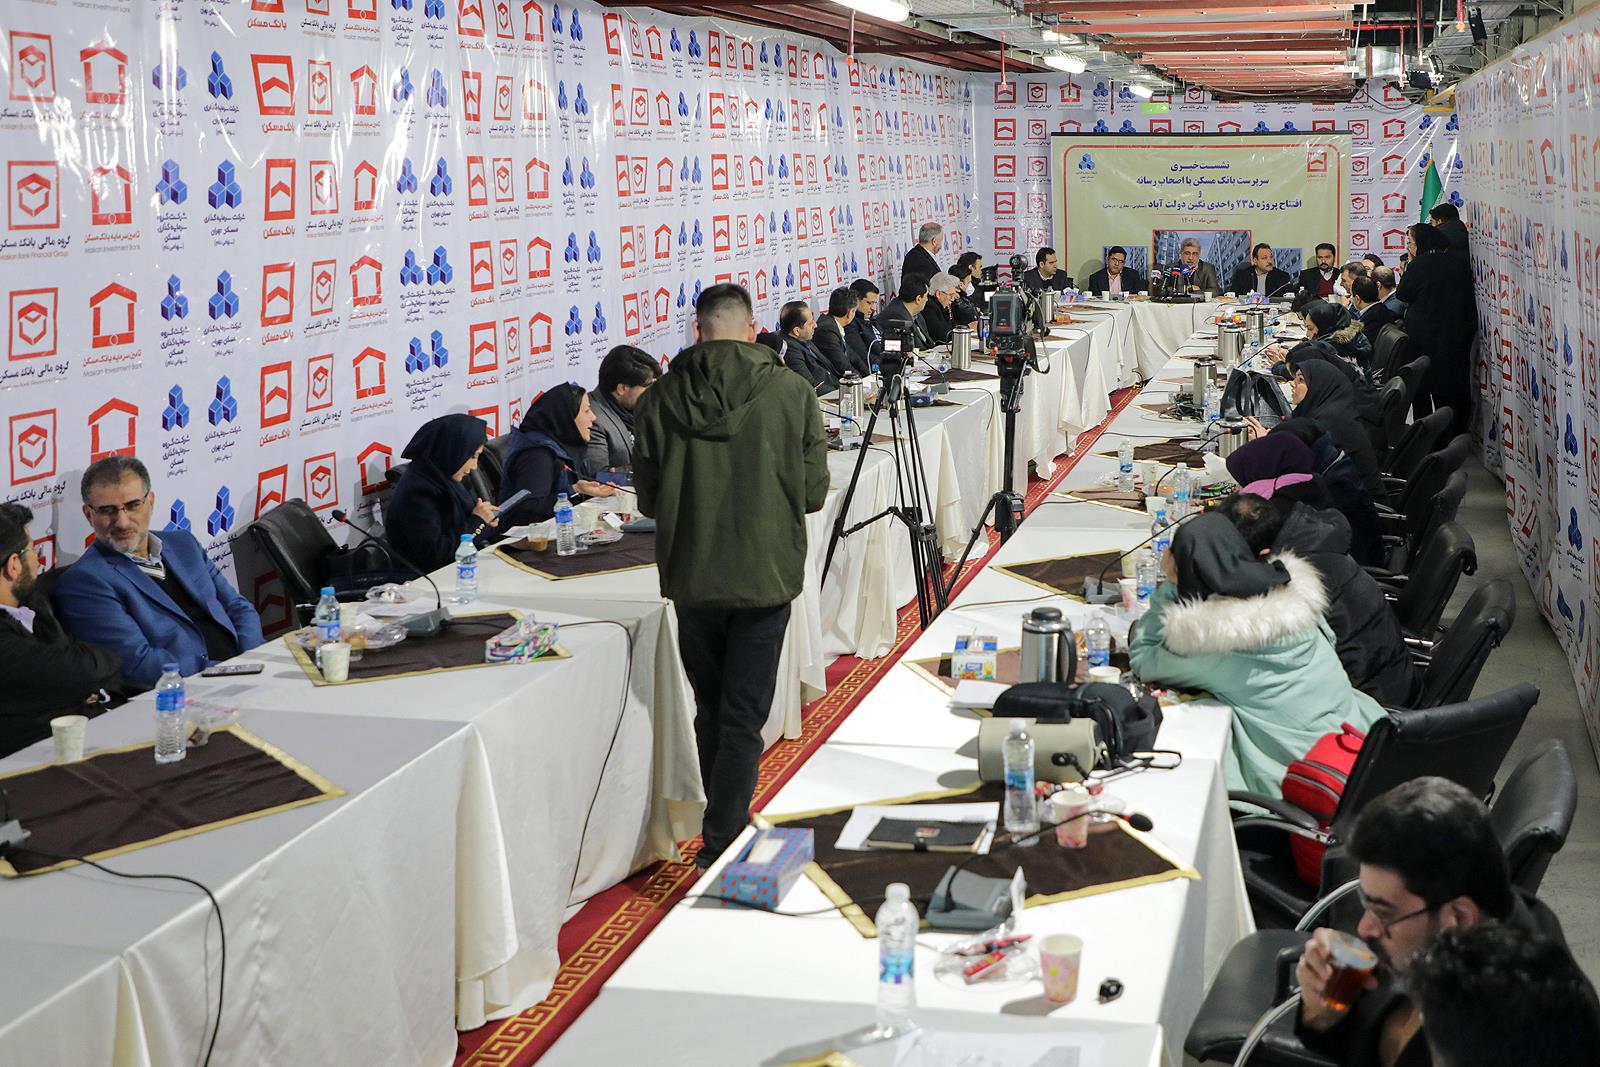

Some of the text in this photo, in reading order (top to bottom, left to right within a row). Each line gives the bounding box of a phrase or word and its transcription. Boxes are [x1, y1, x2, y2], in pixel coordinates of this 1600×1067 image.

[248, 17, 287, 31] بانک مسکن
[1171, 161, 1230, 172] نشست خبری
[1136, 175, 1270, 187] سرپرست بانک مسکن با اصحاب رسانه
[1198, 190, 1203, 198] و
[1148, 199, 1163, 209] آباد
[1165, 200, 1186, 211] دولت
[1188, 200, 1206, 211] نگین
[1207, 200, 1235, 211] واحدی
[1236, 199, 1255, 209] ۲۳۵
[1257, 200, 1278, 211] پروژه
[1279, 199, 1302, 210] افتتاح
[264, 226, 281, 240] مسکن
[281, 225, 296, 236] بانک
[262, 333, 279, 346] مسکن
[278, 331, 294, 341] بانک
[276, 428, 291, 439] بانک
[260, 434, 277, 447] مسکن
